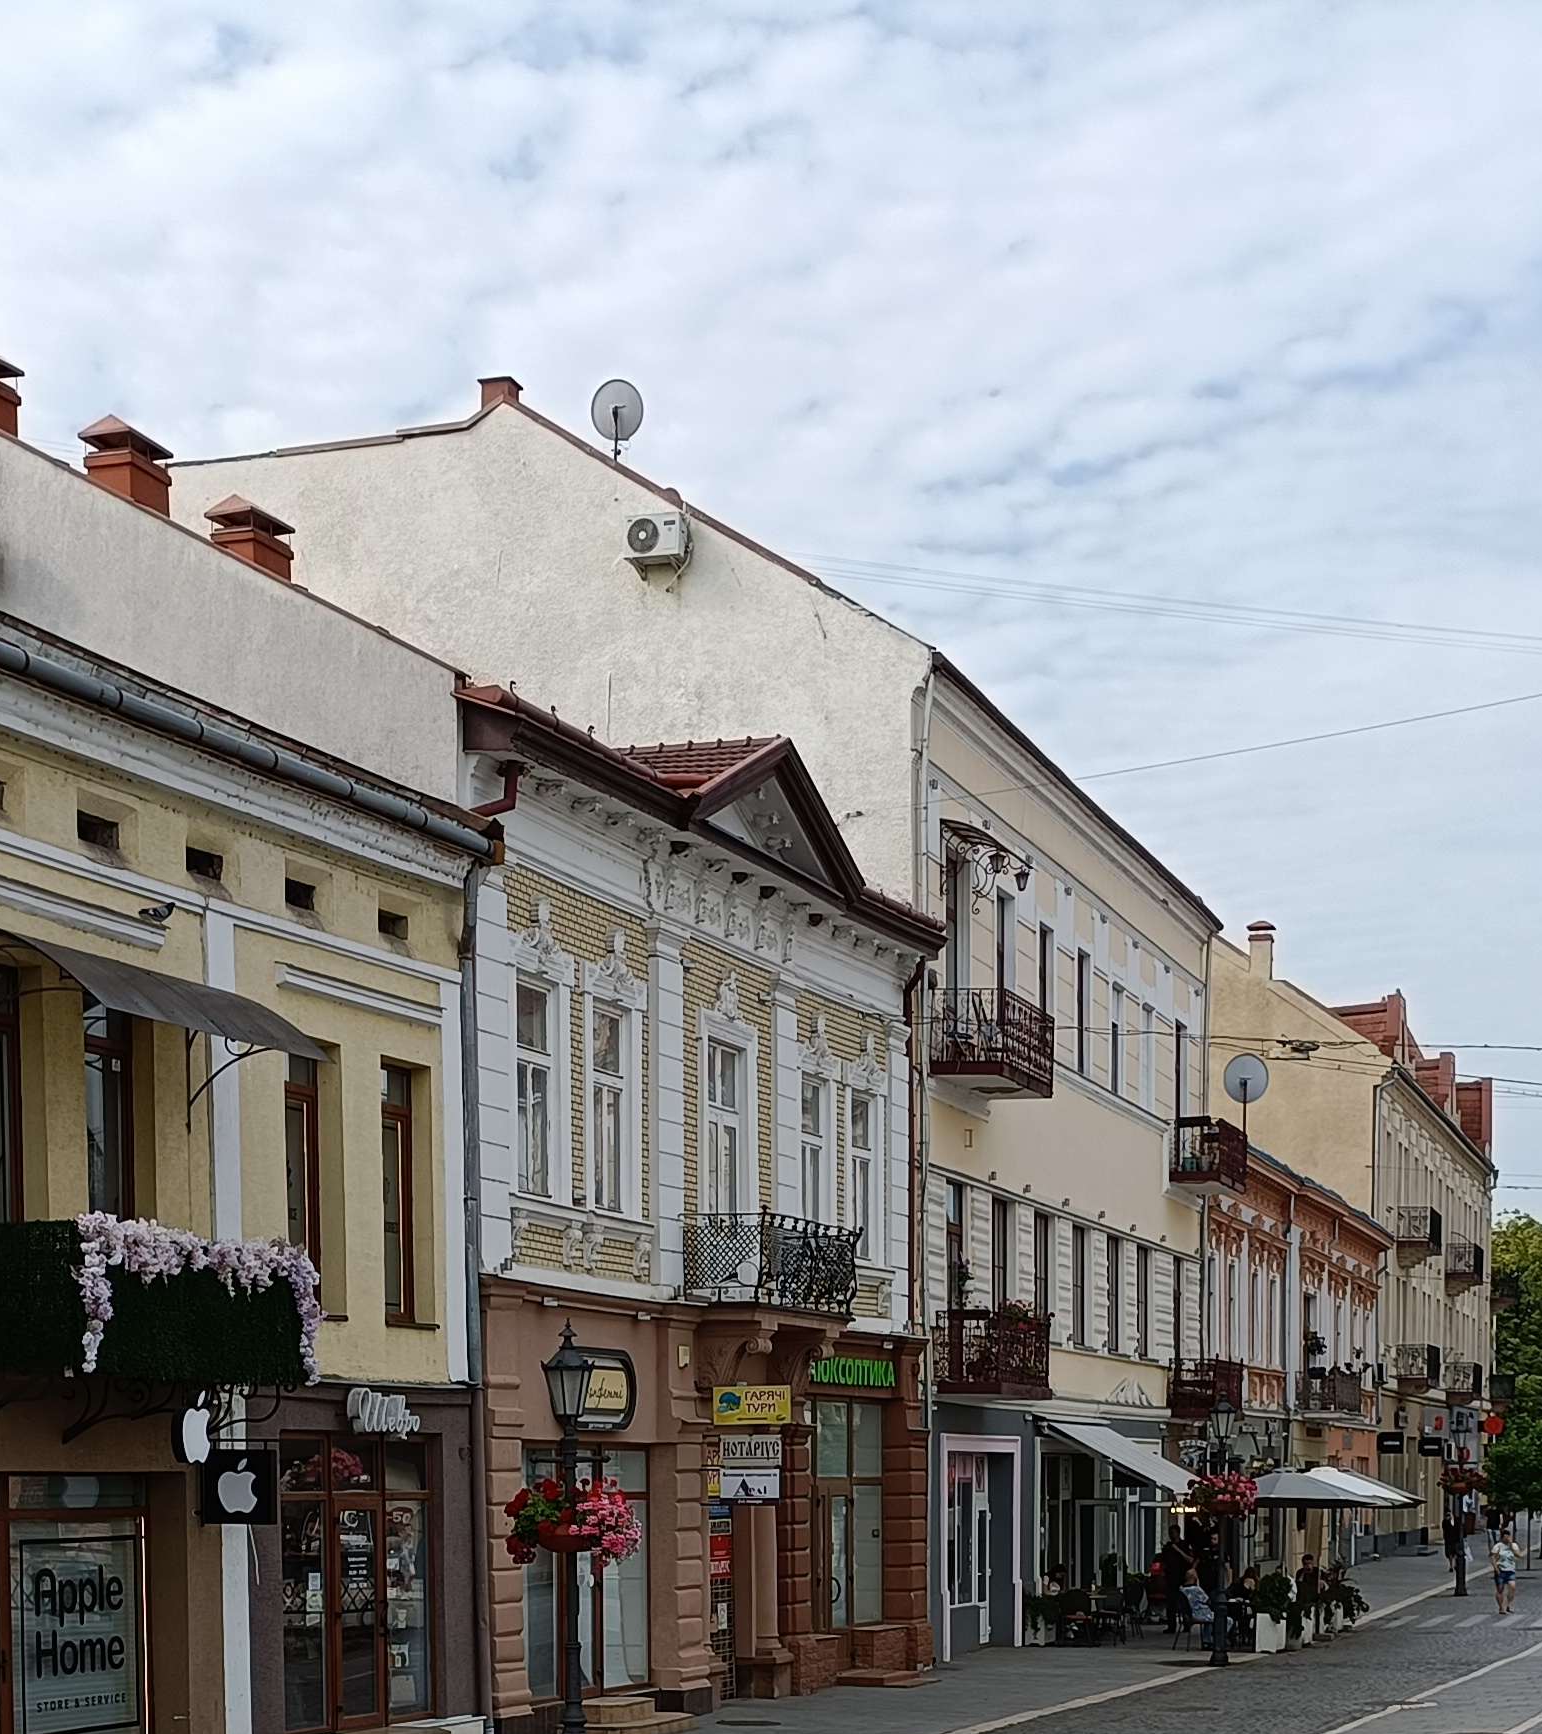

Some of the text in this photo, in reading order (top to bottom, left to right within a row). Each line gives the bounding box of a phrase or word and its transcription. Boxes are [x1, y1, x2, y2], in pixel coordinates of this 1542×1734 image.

[744, 1390, 785, 1401] ГАРЯЧІ
[746, 1403, 776, 1413] ТУРИ
[723, 1441, 779, 1461] НОТАРІУС
[34, 1564, 124, 1627] Apple
[36, 1630, 125, 1679] Home
[37, 1693, 126, 1713] STORE & SERVICE
